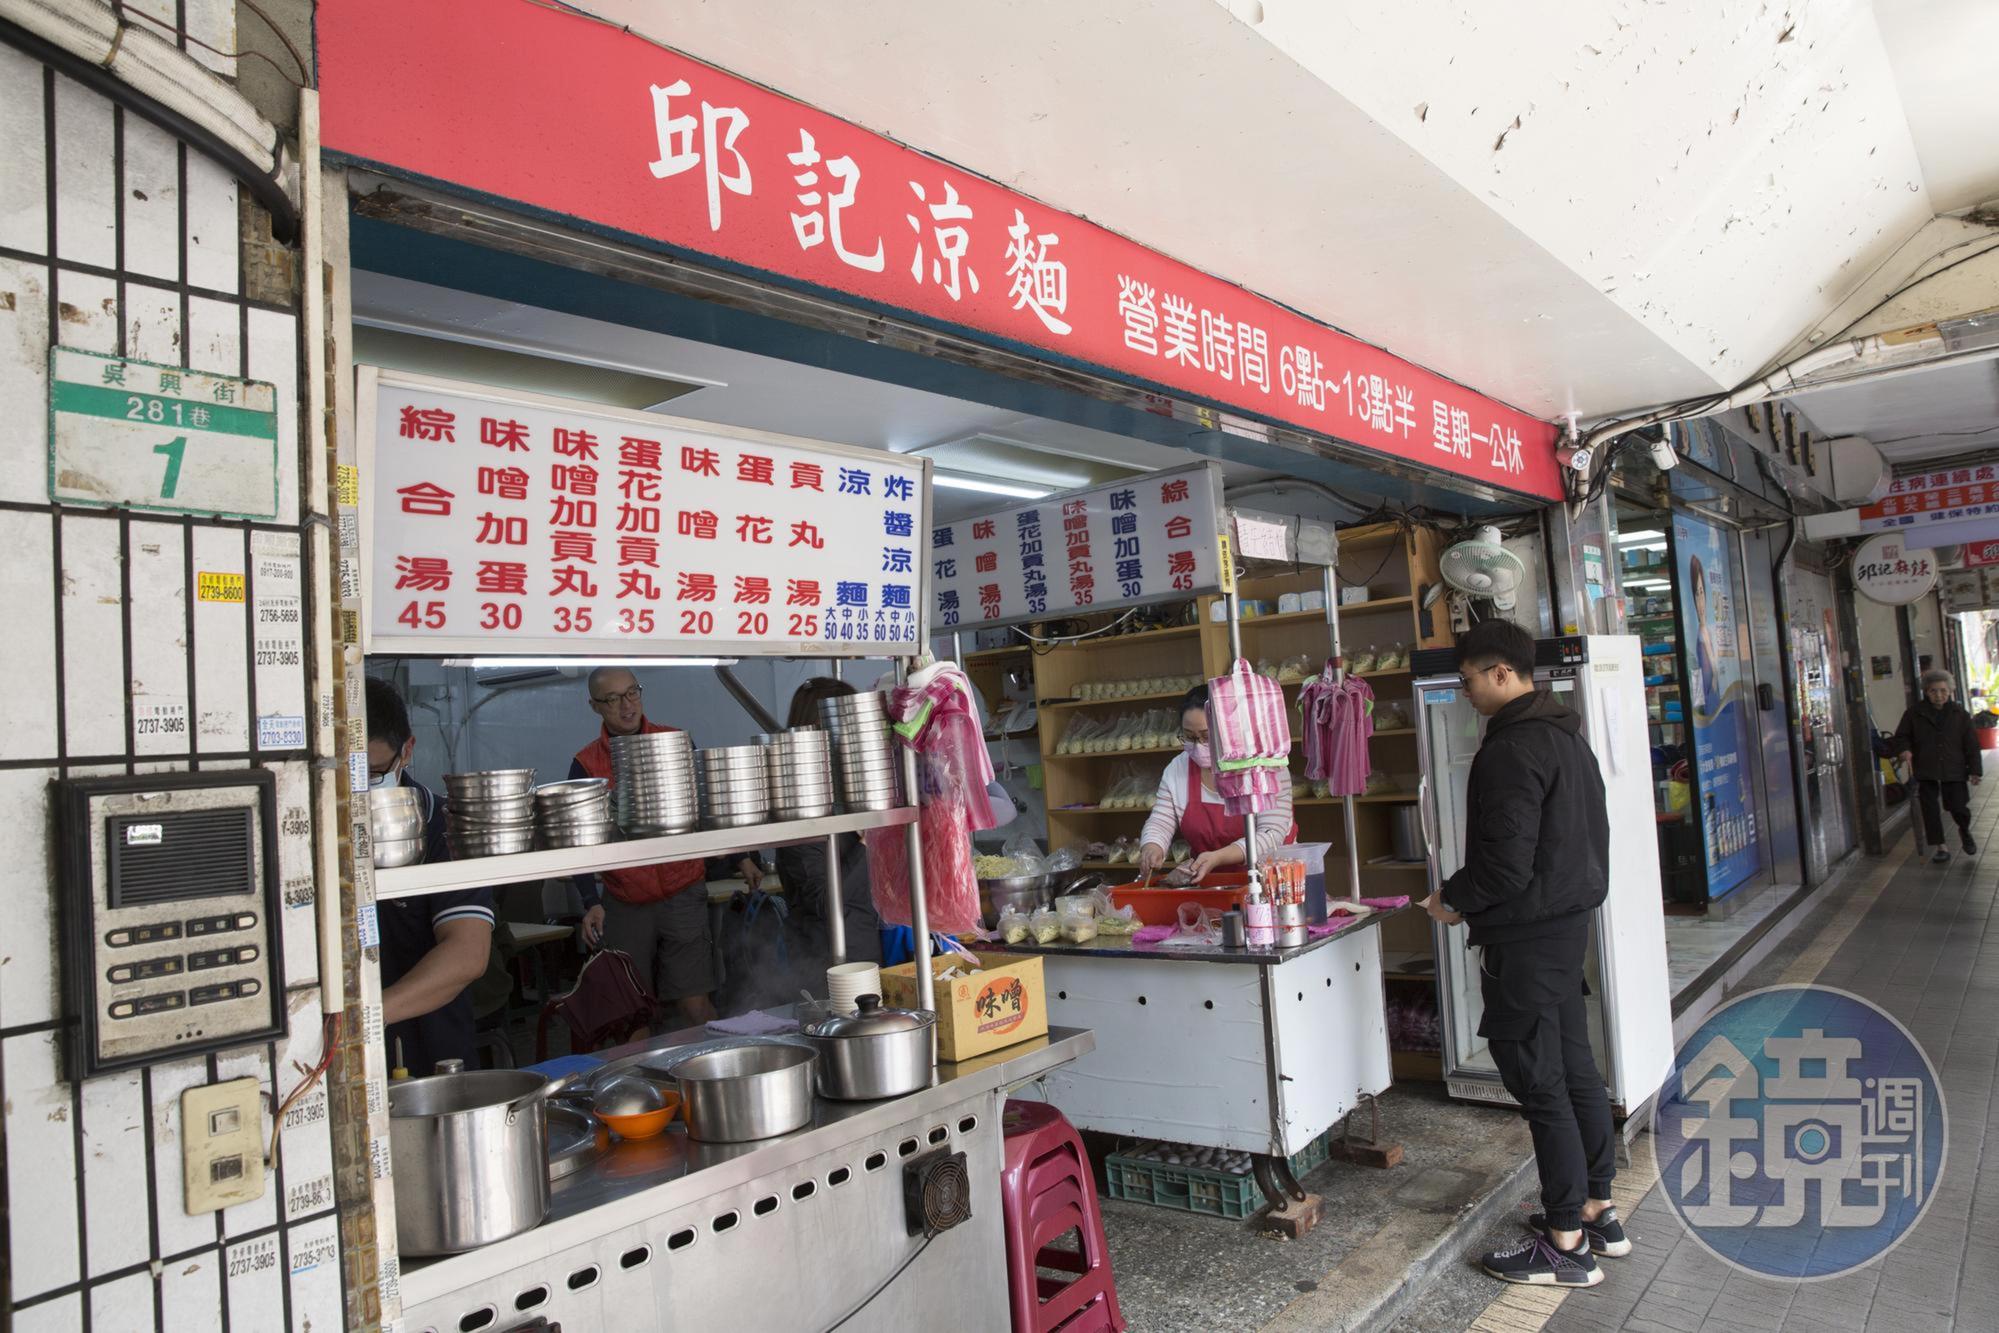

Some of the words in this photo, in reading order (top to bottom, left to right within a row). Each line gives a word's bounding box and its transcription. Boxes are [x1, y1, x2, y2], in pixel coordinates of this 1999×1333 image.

[648, 78, 1072, 336] 邱記涼麵
[102, 363, 236, 404] 吳興街
[1117, 273, 1271, 394] 營業時間
[1279, 345, 1417, 440] 6點~13點半
[1431, 400, 1525, 475] 星期一公休
[126, 396, 211, 427] 281巷
[153, 436, 188, 499] 1
[1889, 465, 1999, 493] 性病連續處
[394, 405, 456, 592] 綜合湯
[475, 417, 531, 596] 味噌加蛋
[549, 428, 599, 600] 味噌加貢丸
[616, 436, 662, 601] 蛋花加貢丸
[677, 446, 721, 602] 味噌湯
[1160, 479, 1196, 575] 綜合湯
[733, 453, 775, 605] 蛋花湯
[786, 462, 825, 607] 貢丸湯
[836, 467, 872, 608] 涼麵
[881, 475, 914, 609] 炸醬涼麵
[1110, 489, 1143, 583] 味噌加蛋
[1016, 509, 1047, 599] 蛋花加貢丸湯
[1062, 500, 1095, 591] 味噌加貢丸湯
[932, 527, 960, 610] 蛋花湯
[972, 520, 1001, 605] 味噌湯
[1122, 582, 1141, 598] 30
[1172, 575, 1193, 590] 45
[984, 605, 1000, 619] 20
[1028, 599, 1046, 613] 35
[1074, 590, 1093, 606] 35
[260, 609, 298, 622] 2756-5658
[398, 601, 447, 629] 45
[480, 602, 523, 630] 30
[553, 607, 593, 633] 35
[618, 608, 655, 634] 35
[680, 611, 714, 635] 20
[737, 613, 769, 636] 20
[788, 614, 818, 637] 25
[825, 607, 836, 621] 大
[842, 608, 852, 622] 中
[857, 608, 869, 622] 小
[874, 608, 886, 622] 大
[890, 609, 900, 623] 中
[904, 610, 915, 624] 小
[944, 611, 959, 625] 20
[824, 622, 837, 641] 50
[840, 622, 853, 641] 40
[856, 622, 869, 641] 35
[874, 623, 887, 641] 60
[888, 623, 901, 642] 50
[903, 623, 915, 642] 45
[257, 651, 299, 665] 2737-3905
[138, 718, 185, 734] 2737-3905
[976, 978, 1022, 1018] 味噌
[286, 1102, 325, 1127] 2737-3905
[290, 1187, 331, 1213] 2739-860
[230, 1252, 275, 1277] 2737-3905
